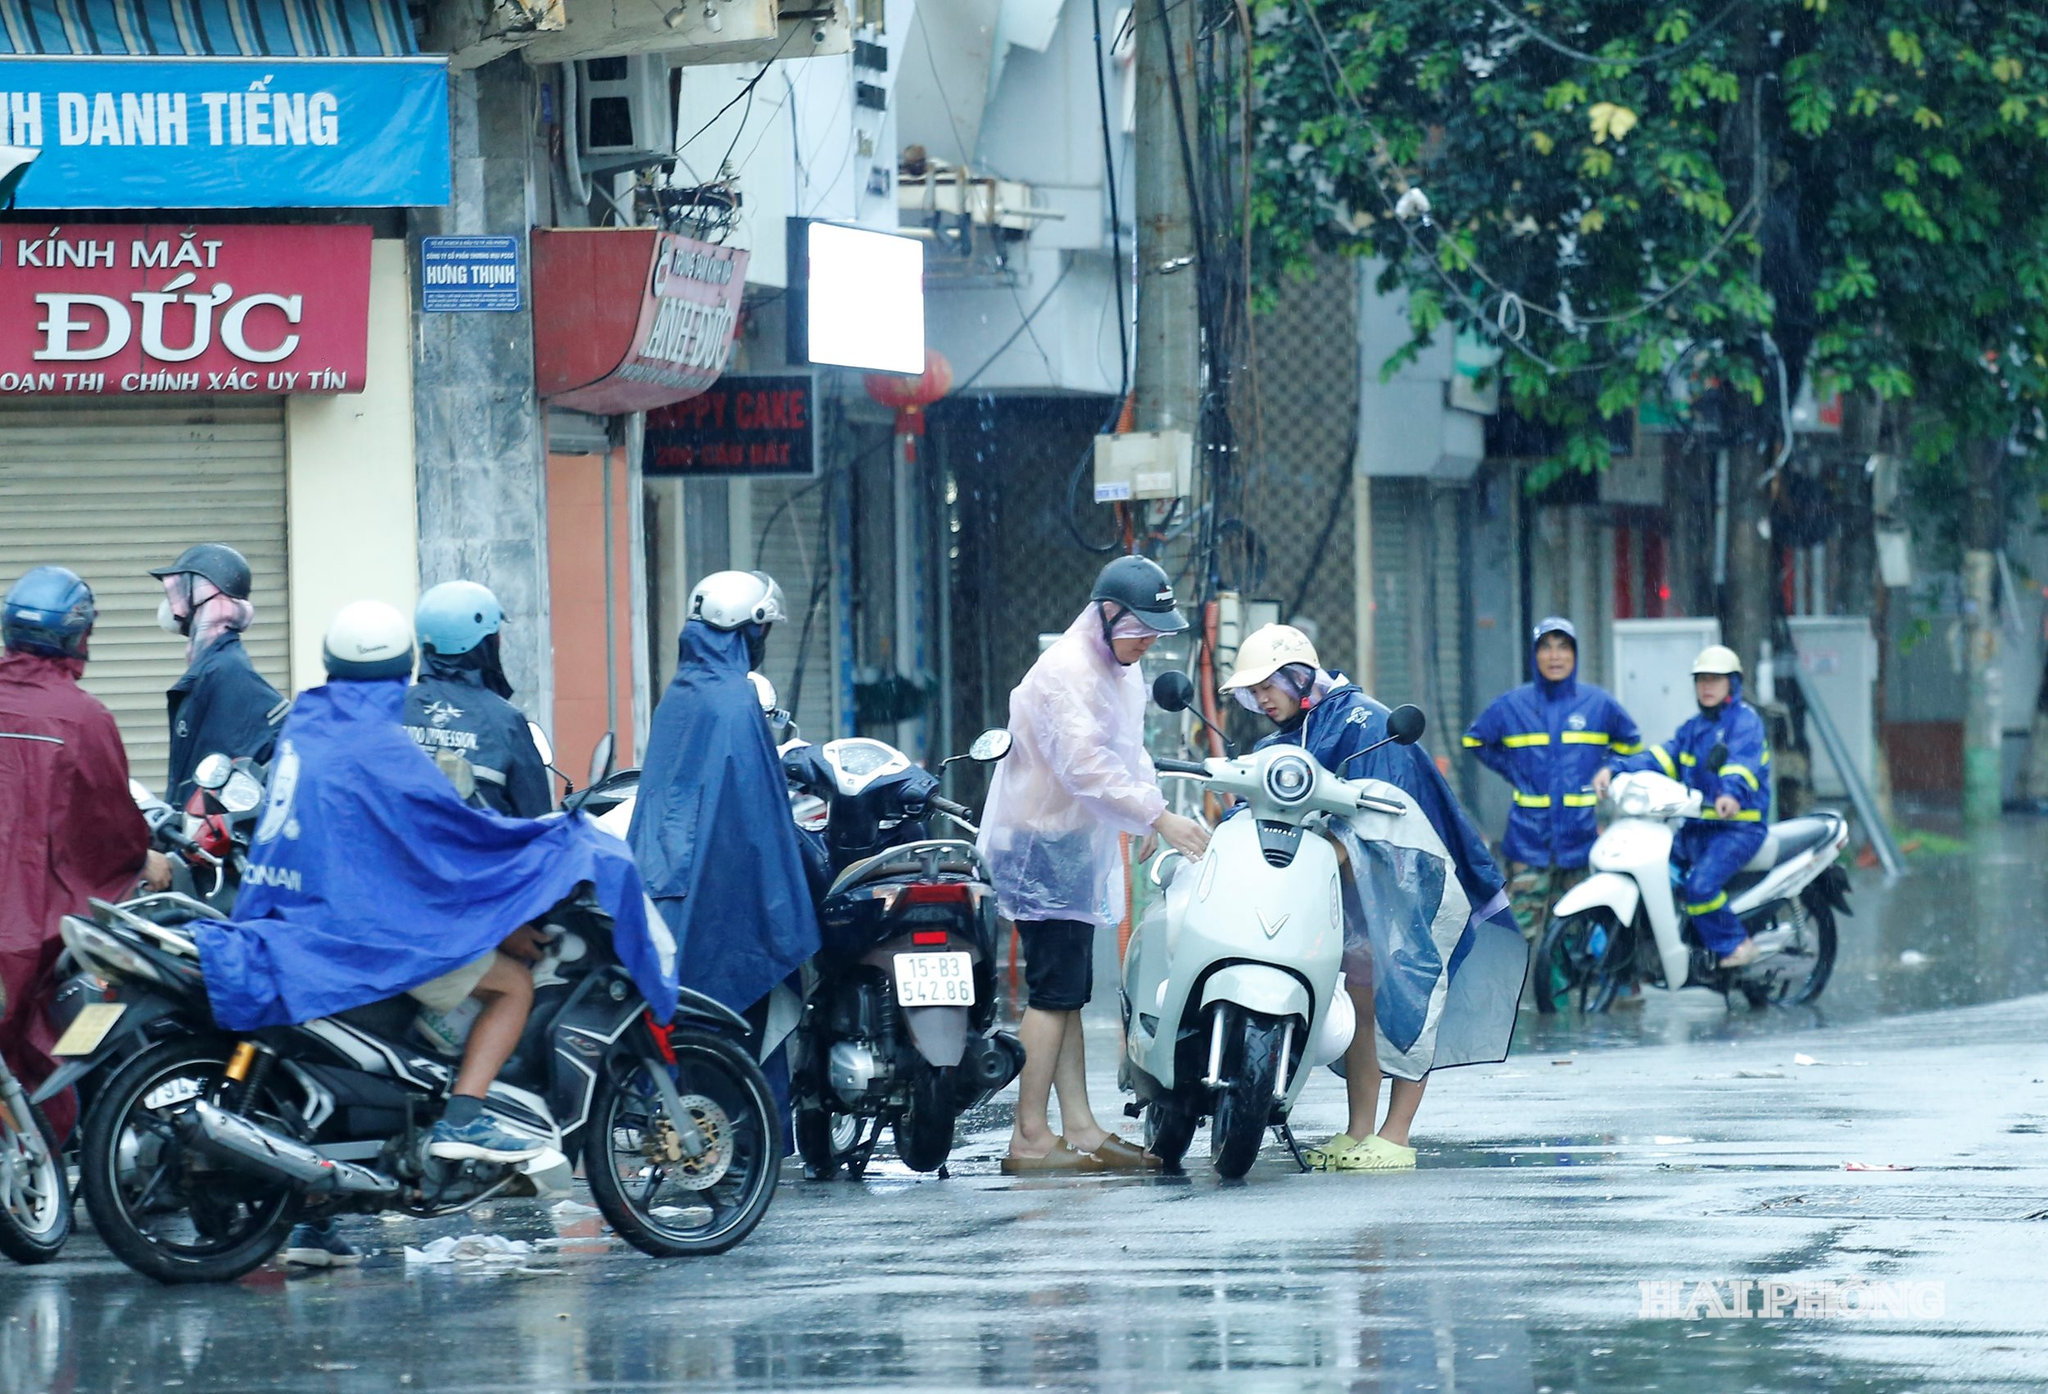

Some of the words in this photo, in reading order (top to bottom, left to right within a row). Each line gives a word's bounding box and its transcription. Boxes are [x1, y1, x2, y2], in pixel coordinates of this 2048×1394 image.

[58, 92, 187, 146] DANH
[202, 74, 339, 146] TIẾNG
[18, 226, 115, 268] KÍNH
[131, 225, 223, 268] MẮT
[426, 263, 468, 285] HƯNG
[471, 264, 515, 288] THỊNH
[33, 272, 303, 364] ĐỨC
[0, 372, 55, 393] OẠN
[62, 372, 105, 393] THỊ
[121, 369, 199, 392] CHÍNH
[207, 367, 258, 391] XÁC
[267, 371, 300, 390] UY
[308, 367, 347, 390] TÍN
[737, 390, 805, 429] CAKE
[908, 957, 960, 979] 15-B3
[903, 980, 970, 1001] 542.86
